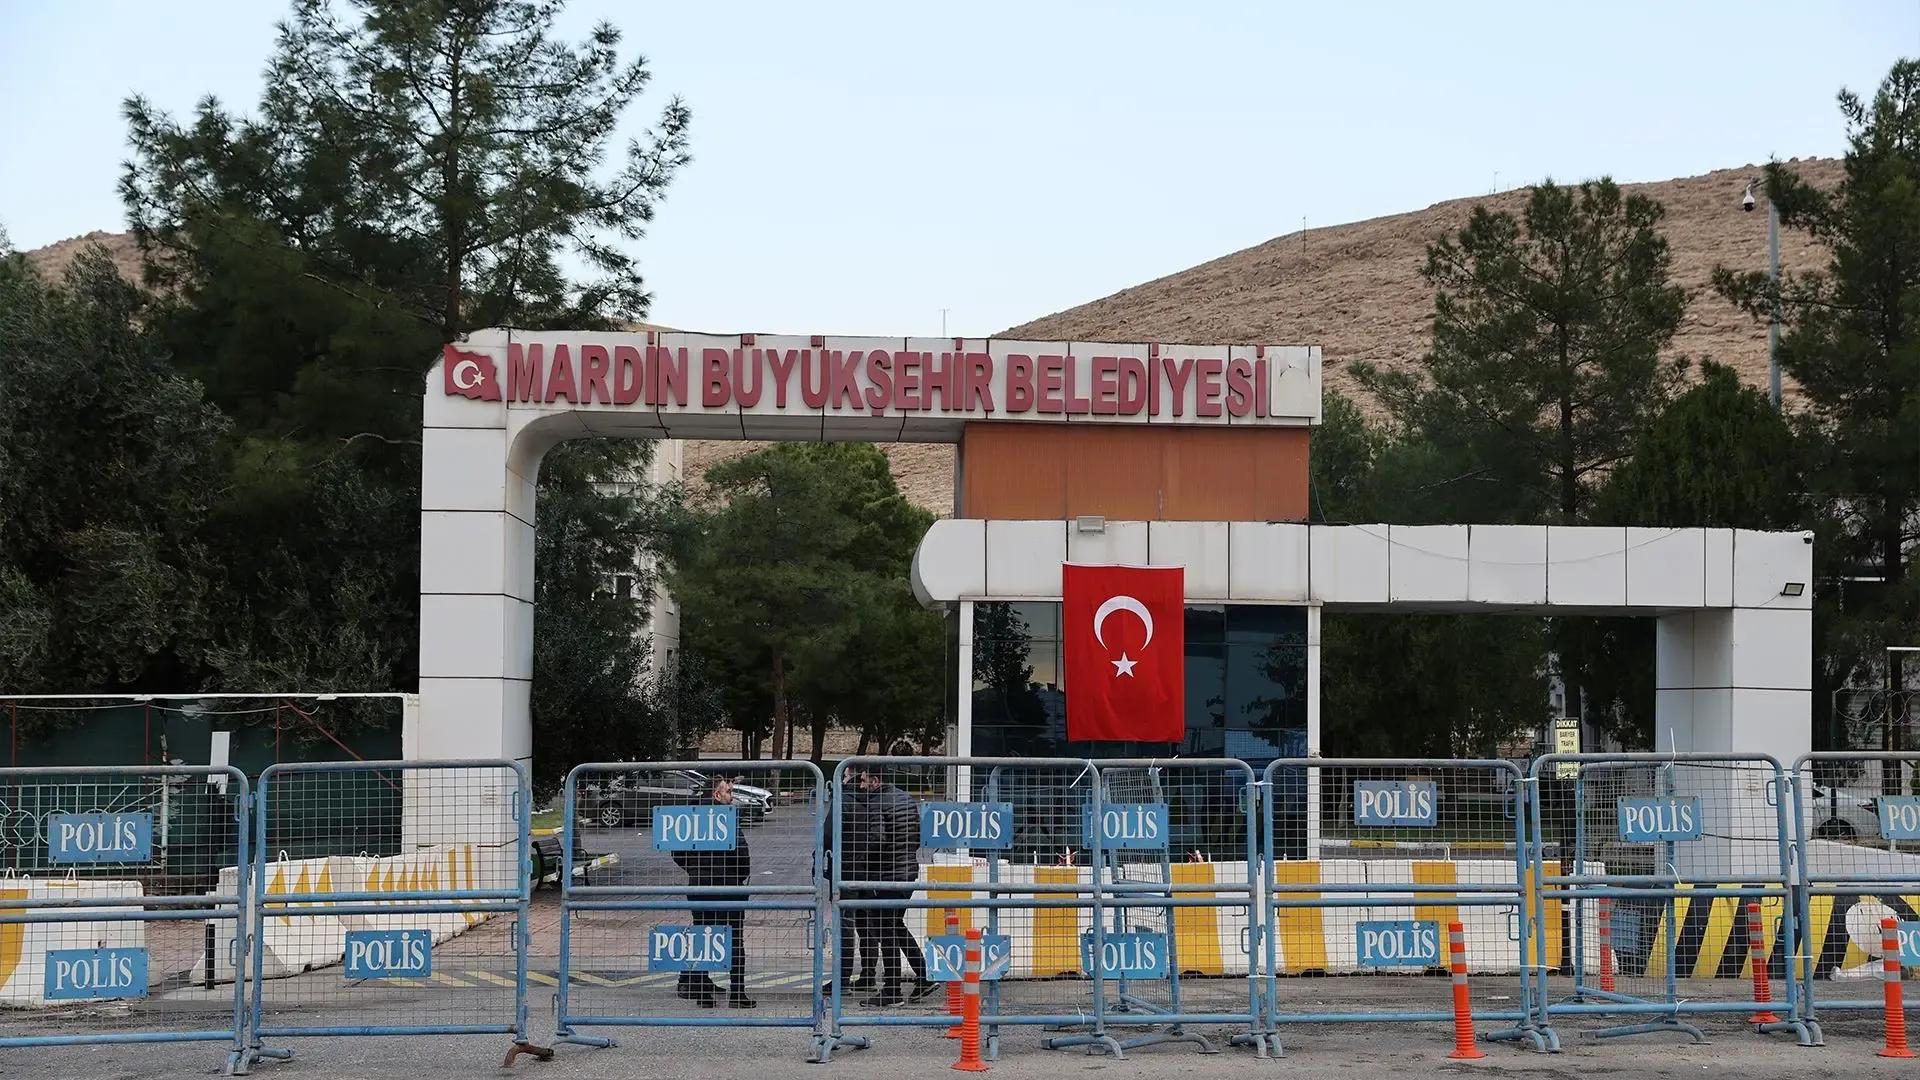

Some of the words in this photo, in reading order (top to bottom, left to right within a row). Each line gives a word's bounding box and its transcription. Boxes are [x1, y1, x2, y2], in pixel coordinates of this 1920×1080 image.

[506, 331, 688, 406] MARDİN
[702, 333, 995, 418] BÜYÜKŞEHİR
[1005, 342, 1267, 418] BELEDİYESİ
[1359, 783, 1432, 819] POLİS
[1624, 800, 1694, 834] POLİS
[60, 815, 137, 852] POLİS
[661, 808, 728, 842] POLİS
[931, 804, 1001, 839] POLİS
[1089, 805, 1158, 839] OLİS
[349, 932, 425, 970] POLİS
[652, 926, 726, 962] POLİS
[931, 938, 1000, 972] POİS
[1363, 921, 1435, 959] POLİS
[55, 952, 133, 990] POLİS
